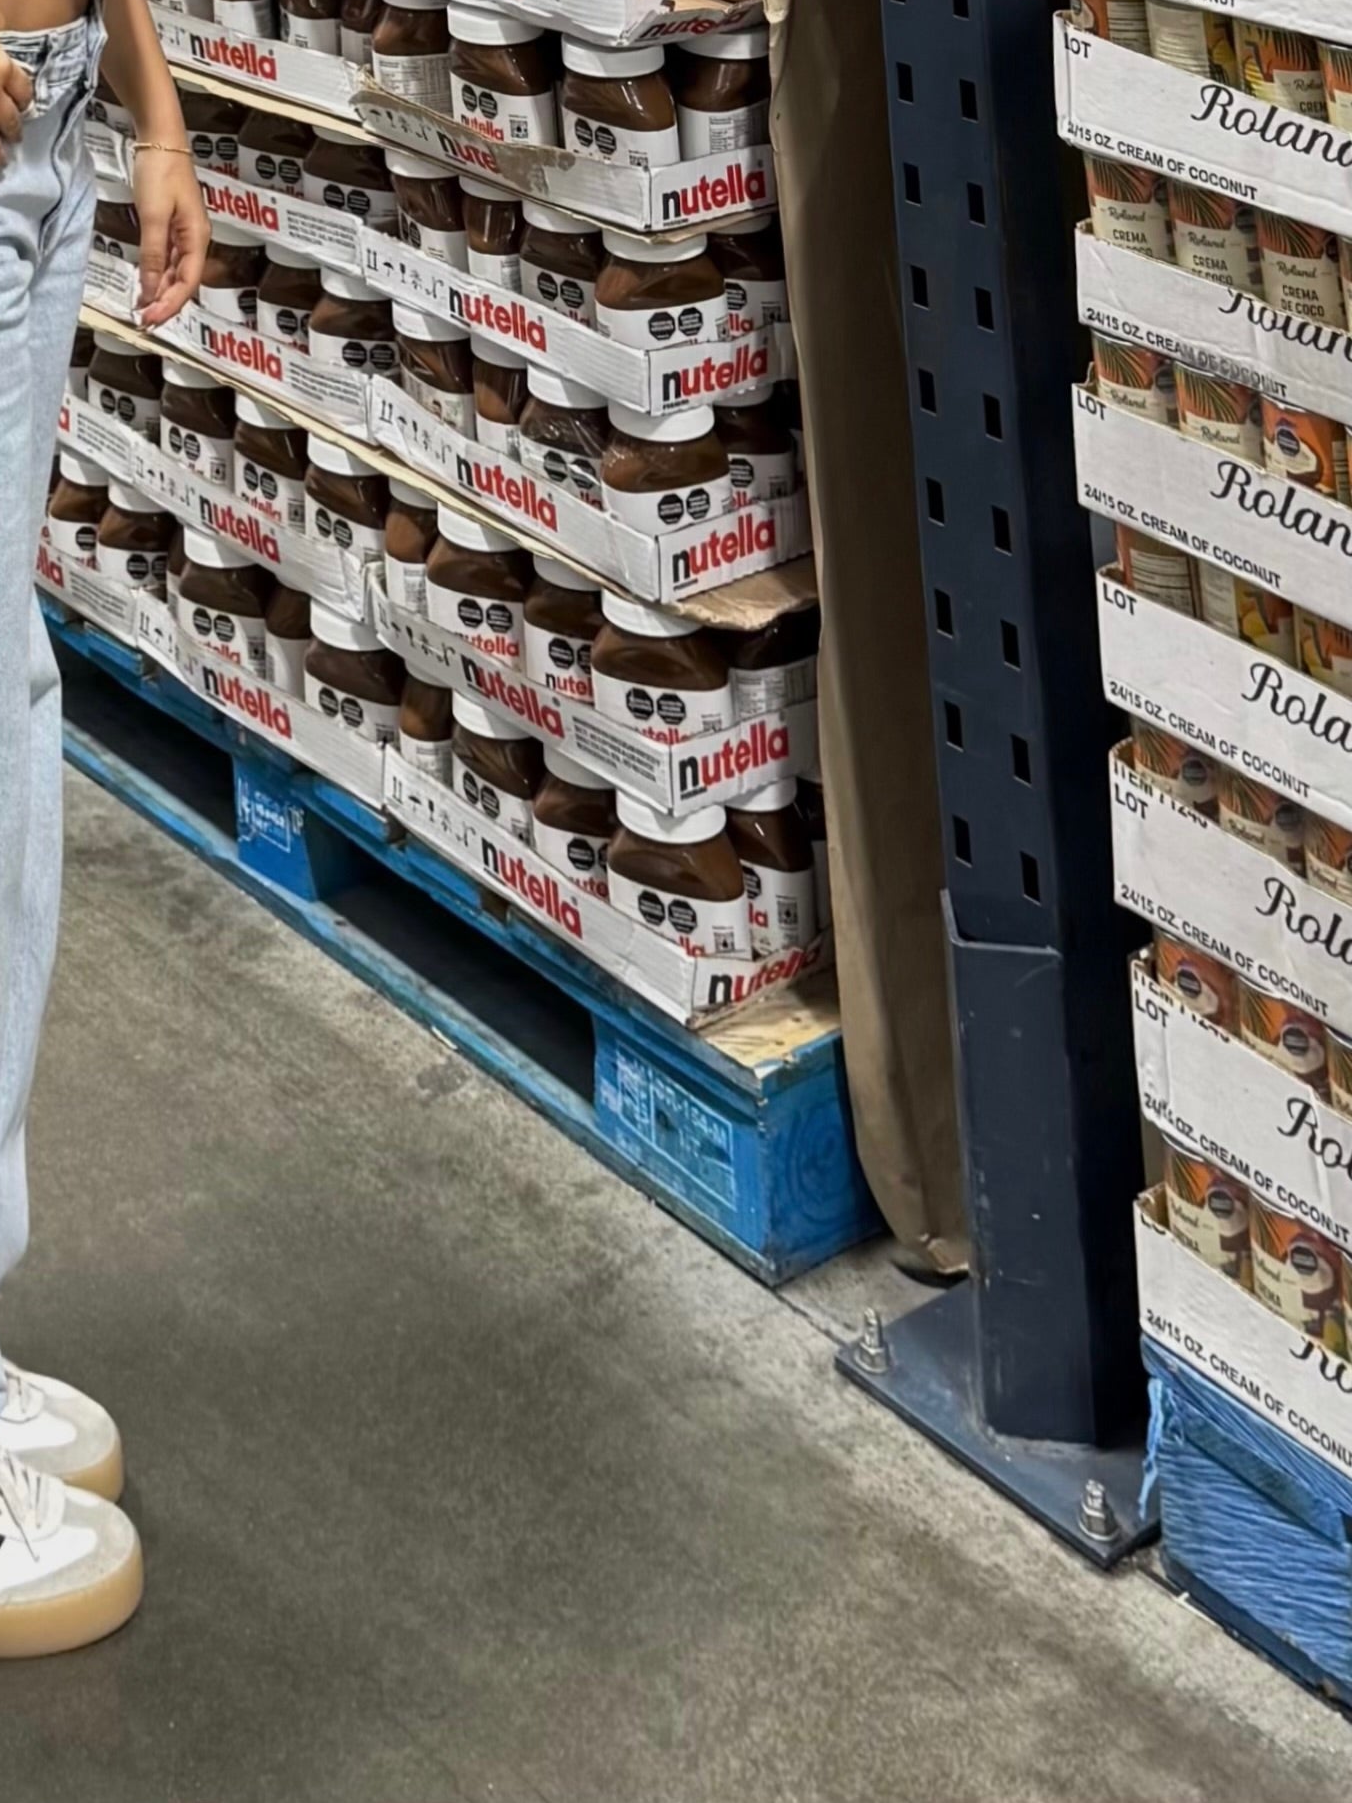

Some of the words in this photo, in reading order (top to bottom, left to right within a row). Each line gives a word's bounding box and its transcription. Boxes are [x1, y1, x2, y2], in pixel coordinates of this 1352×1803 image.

[189, 30, 277, 81] nutella
[1094, 133, 1114, 151] OZ.
[1117, 139, 1164, 169] CREAM
[1167, 157, 1186, 175] OF
[1189, 166, 1259, 199] COCONUT
[199, 180, 279, 232] nutella
[662, 163, 766, 219] nutella
[1107, 206, 1147, 223] Roland
[1112, 228, 1147, 244] CREMA
[1187, 231, 1226, 249] Roland
[1192, 254, 1228, 271] CREMA
[1277, 260, 1318, 280] Roland
[1281, 299, 1295, 312] DE
[1296, 303, 1325, 318] COCO
[1282, 284, 1319, 302] CREMA
[449, 285, 547, 353] nutella
[1086, 306, 1120, 335] 24/15
[1122, 320, 1144, 340] OZ.
[200, 322, 283, 381] nutella
[661, 343, 768, 402] nutella
[1077, 389, 1107, 421] LOT
[1084, 483, 1115, 510] 24/15
[1117, 499, 1139, 521] OZ.
[1141, 511, 1189, 546] CREAM
[1191, 535, 1210, 554] OF
[1212, 543, 1282, 589] COCONUT
[1101, 583, 1138, 616] LOT
[1108, 680, 1142, 709] 24/15
[1143, 699, 1167, 723] OZ.
[1168, 711, 1216, 750] CREAM
[1219, 740, 1238, 760] OF
[1241, 749, 1310, 798] COCONUT
[1114, 782, 1149, 819] LOT
[1119, 884, 1155, 915] 24/15
[1156, 904, 1180, 930] OZ.
[1182, 918, 1232, 960] CREAM
[1234, 951, 1254, 974] OF
[1257, 963, 1329, 1018] COCONUT
[1133, 992, 1170, 1028] LOT
[1146, 1308, 1181, 1345] 24/15
[1183, 1332, 1207, 1362] OZ.
[1209, 1353, 1261, 1401] CREAM
[1264, 1392, 1285, 1415] OF
